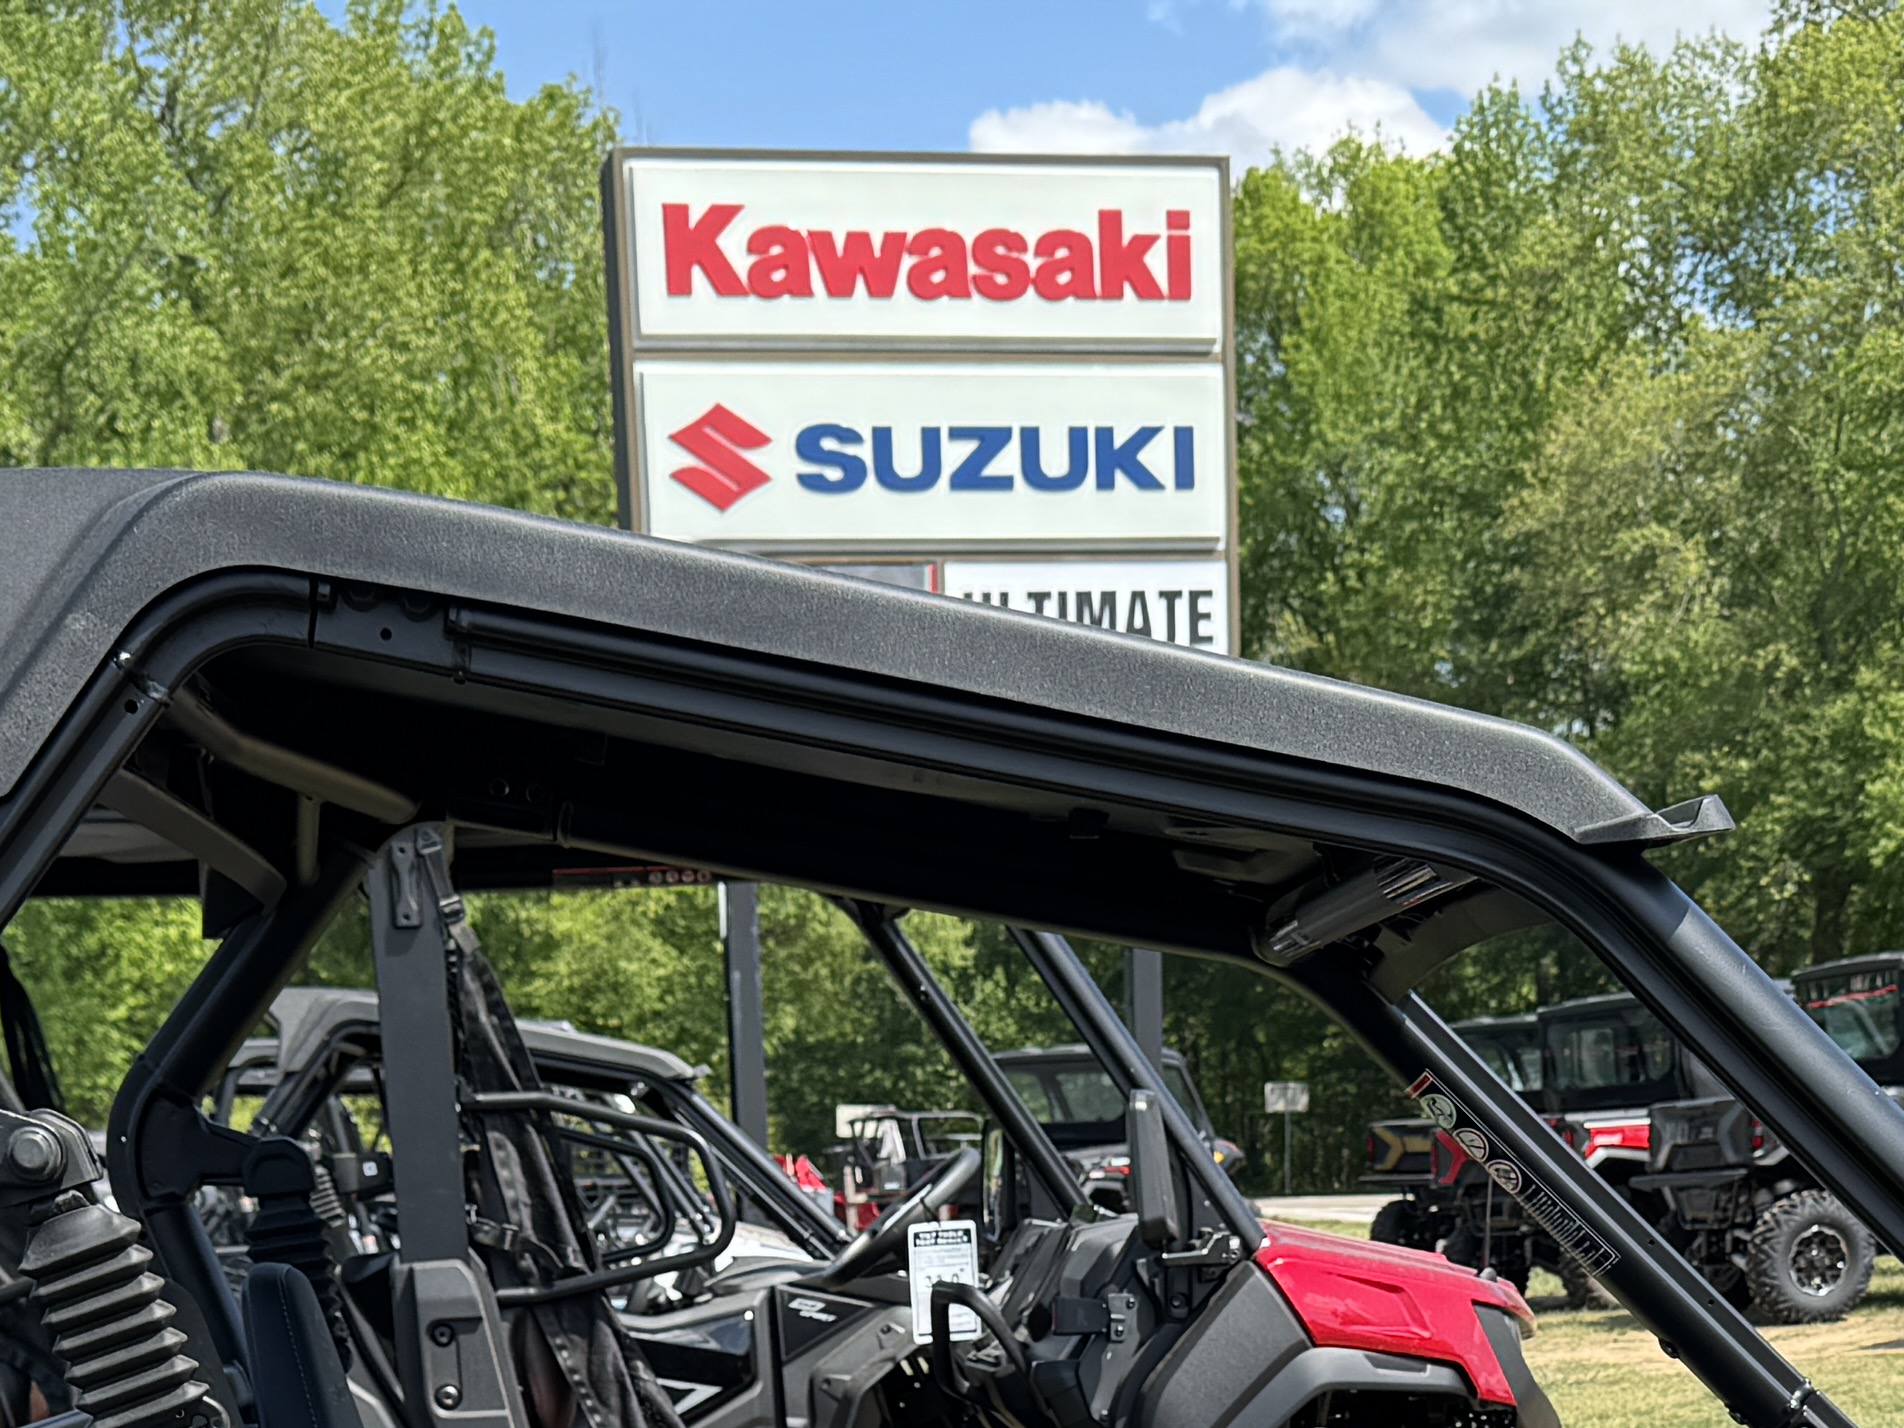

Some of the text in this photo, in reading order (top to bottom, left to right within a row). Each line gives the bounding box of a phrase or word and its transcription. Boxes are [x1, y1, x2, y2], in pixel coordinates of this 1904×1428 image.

[661, 203, 1192, 301] Kawasaki
[795, 423, 1194, 492] SUZUKI
[962, 589, 1214, 646] TIMATE
